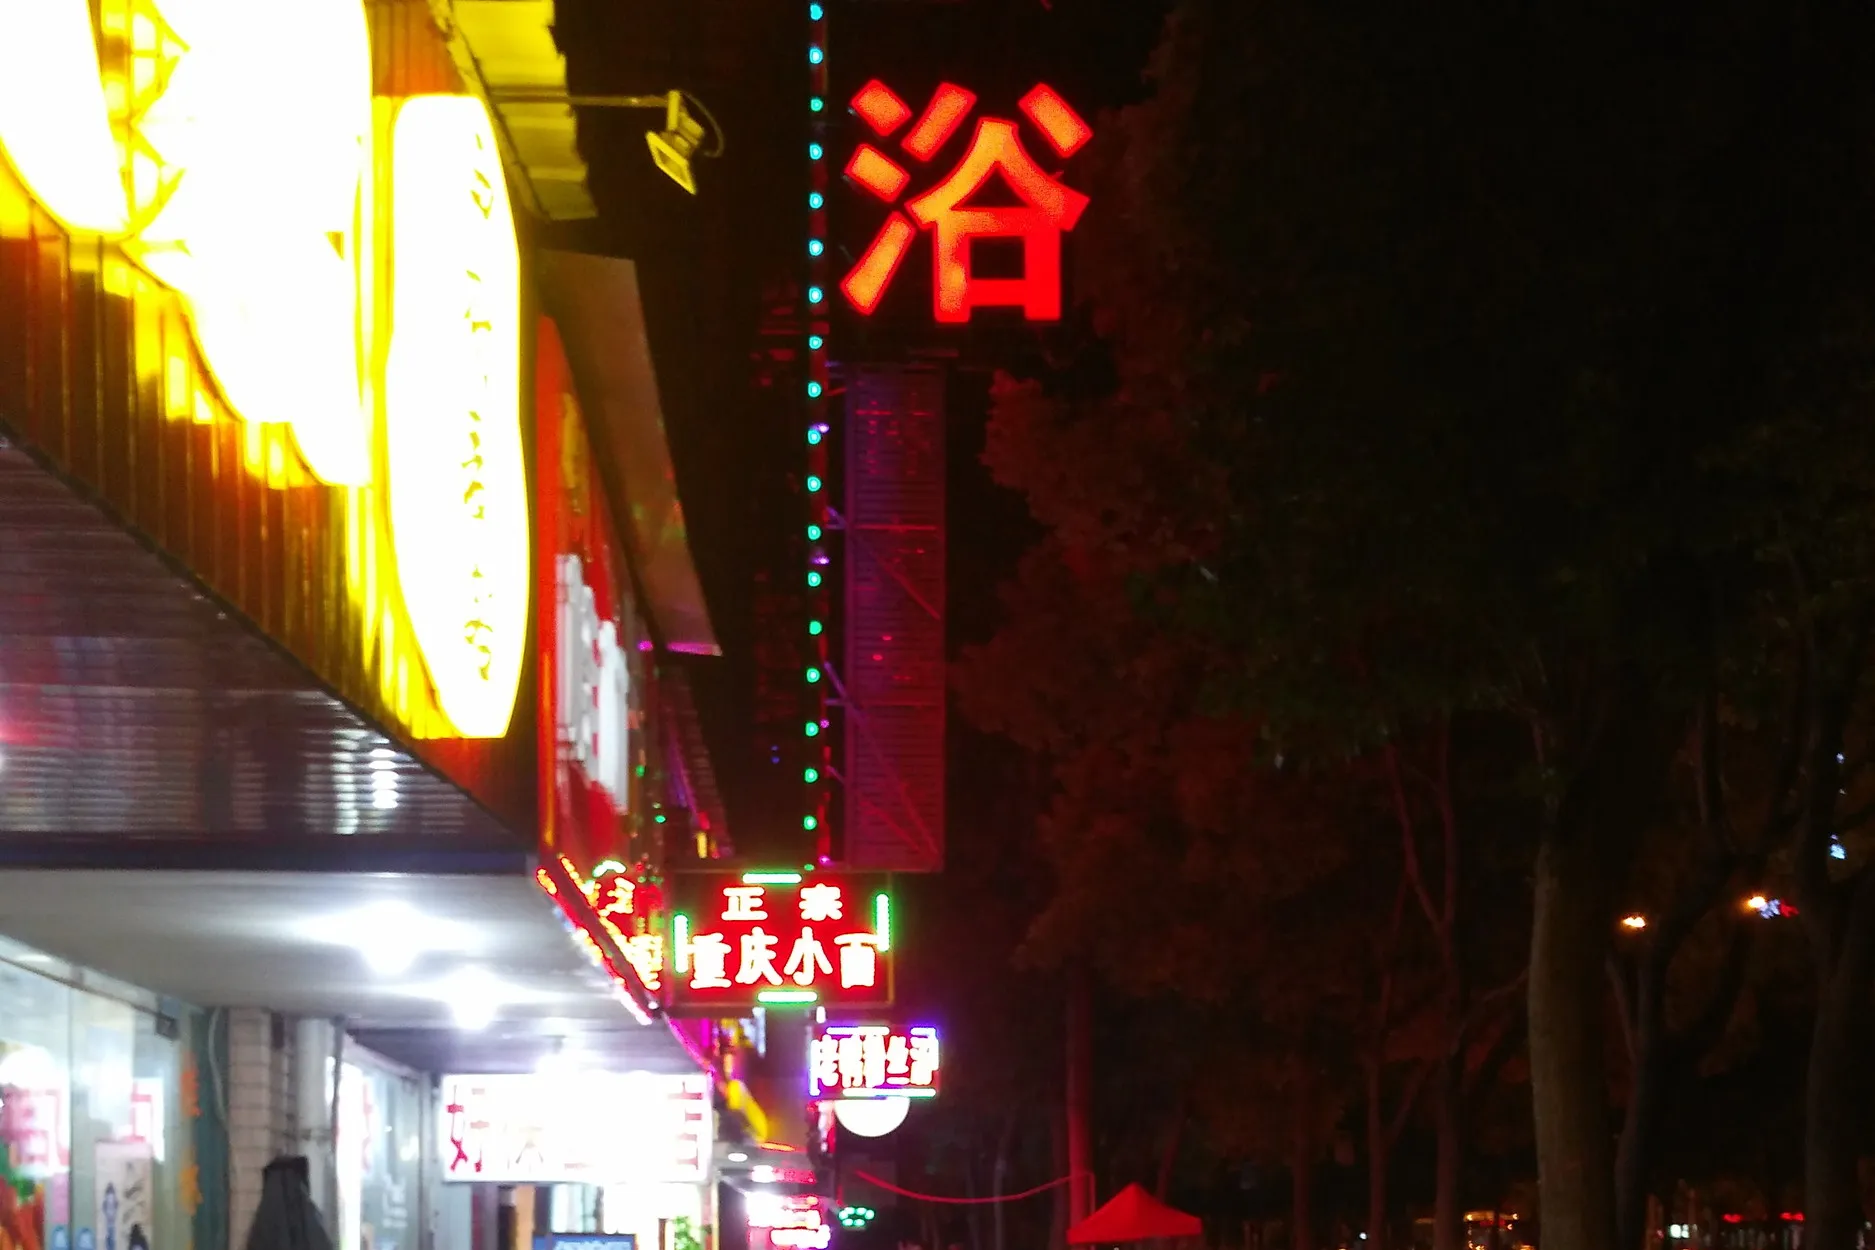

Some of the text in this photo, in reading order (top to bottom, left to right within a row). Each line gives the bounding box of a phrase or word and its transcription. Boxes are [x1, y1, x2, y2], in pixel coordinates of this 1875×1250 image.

[840, 79, 1093, 323] 浴
[721, 884, 843, 921] 正宗
[688, 926, 879, 989] 重庆小面
